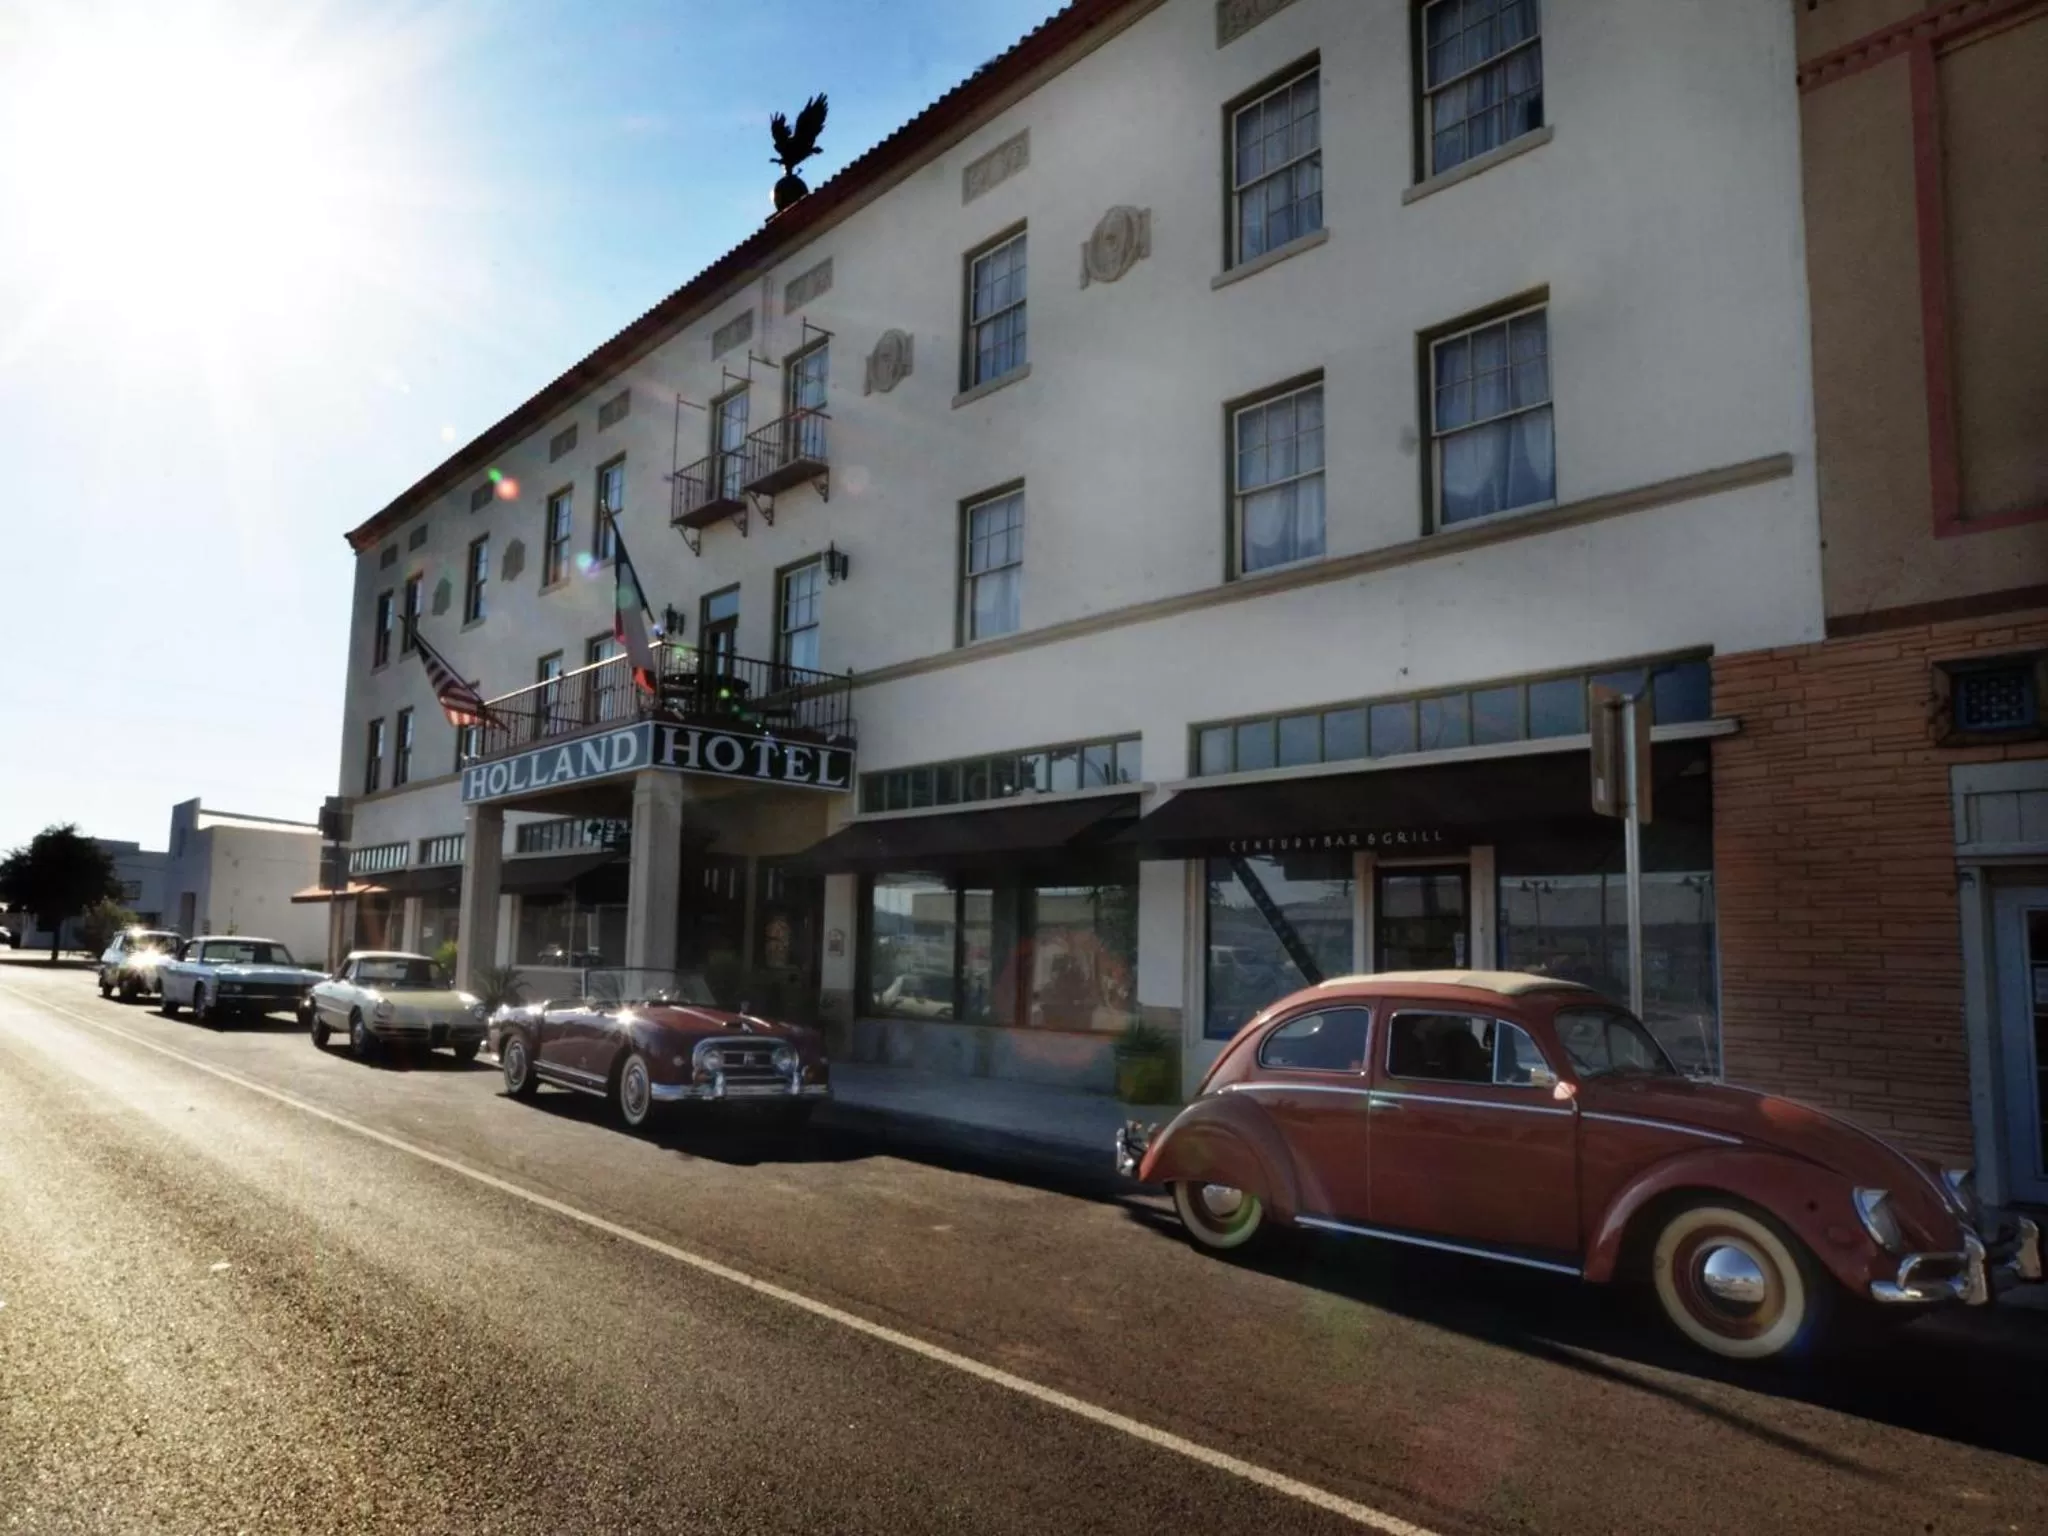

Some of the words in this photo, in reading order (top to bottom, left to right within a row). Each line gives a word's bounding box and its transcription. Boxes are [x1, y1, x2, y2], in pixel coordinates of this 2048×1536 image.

[466, 730, 639, 801] HOLLAND
[661, 727, 845, 787] HOTEL
[1229, 837, 1316, 852] CENTURY
[1323, 834, 1359, 847] BAR
[1381, 830, 1443, 845] GRILL
